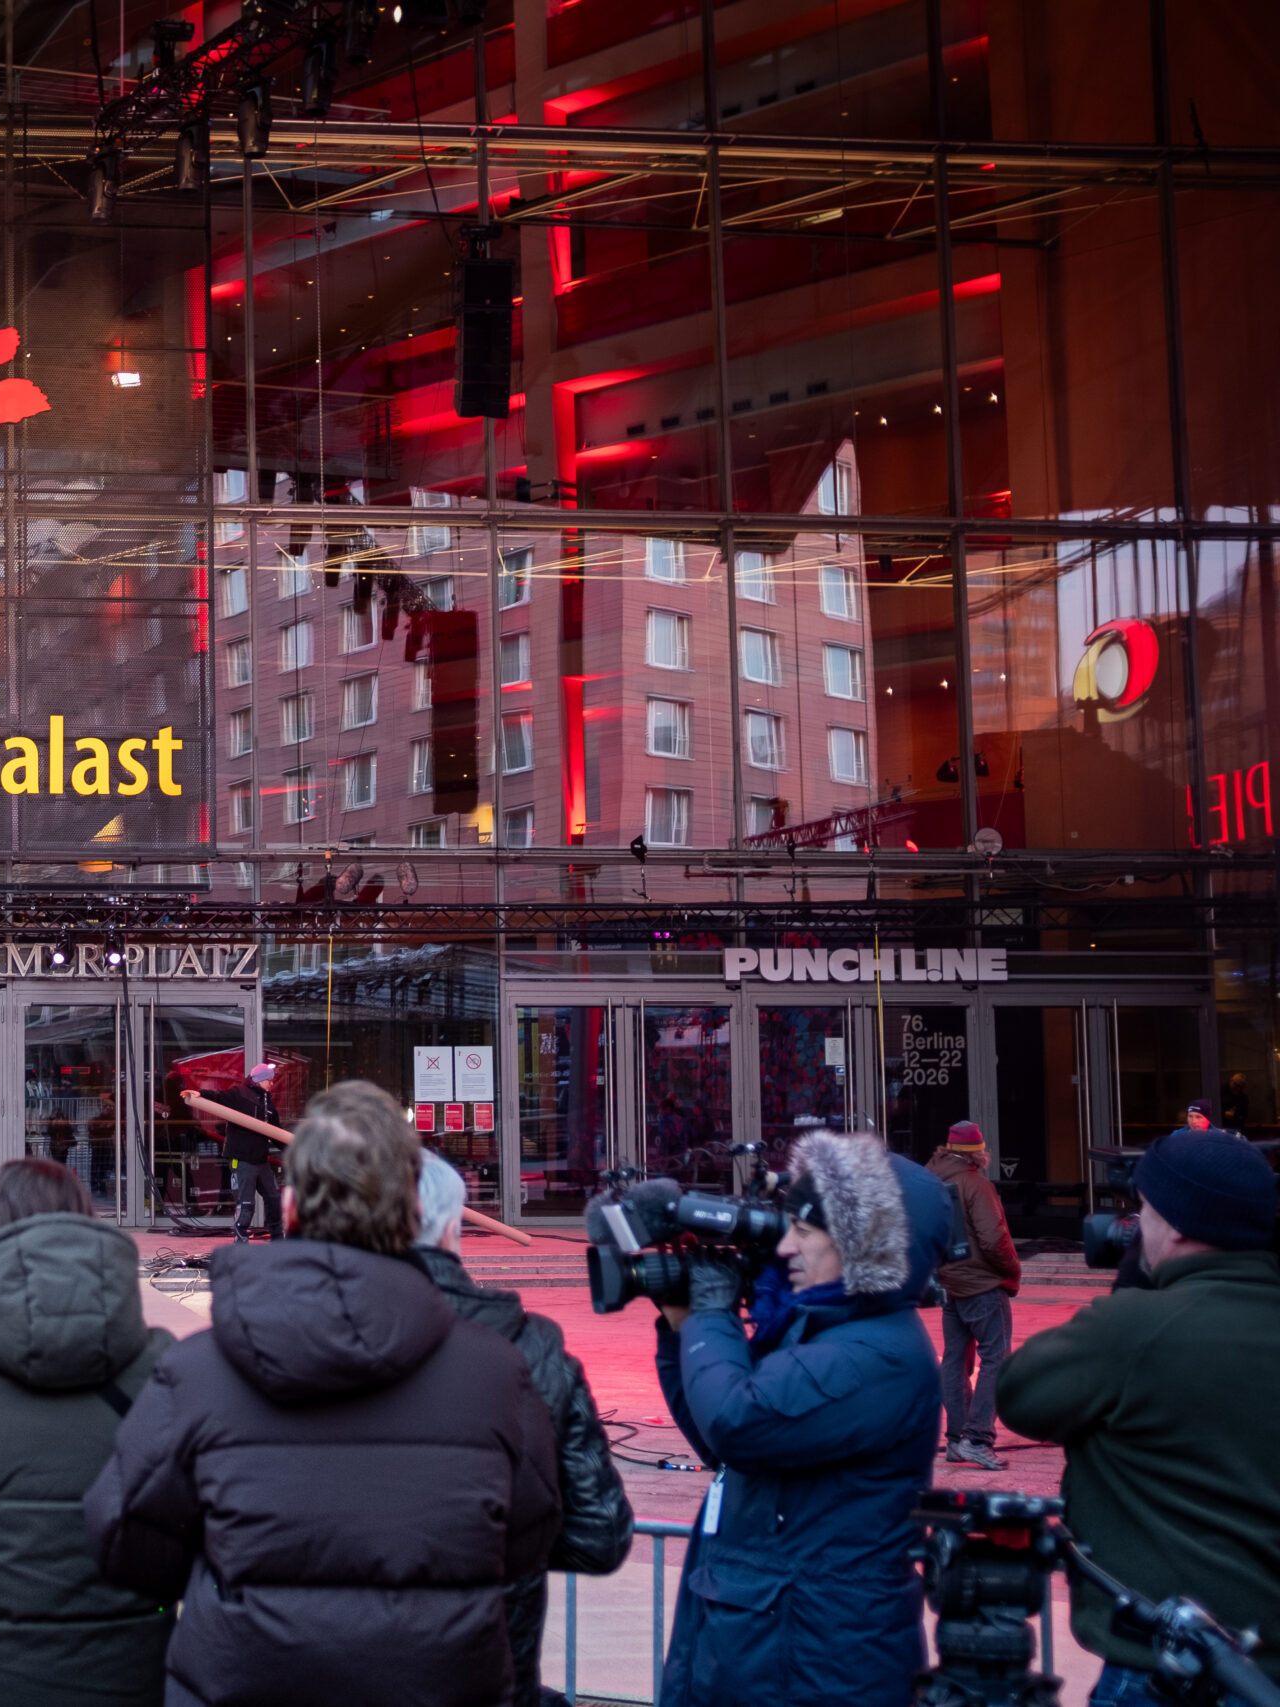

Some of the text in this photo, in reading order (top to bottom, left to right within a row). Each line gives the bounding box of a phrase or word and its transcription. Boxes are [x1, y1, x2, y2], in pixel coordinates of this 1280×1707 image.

[124, 943, 260, 978] PLATZ
[901, 1015, 928, 1032] 76.
[902, 1032, 966, 1050] Berlina
[903, 1068, 950, 1086] 2026
